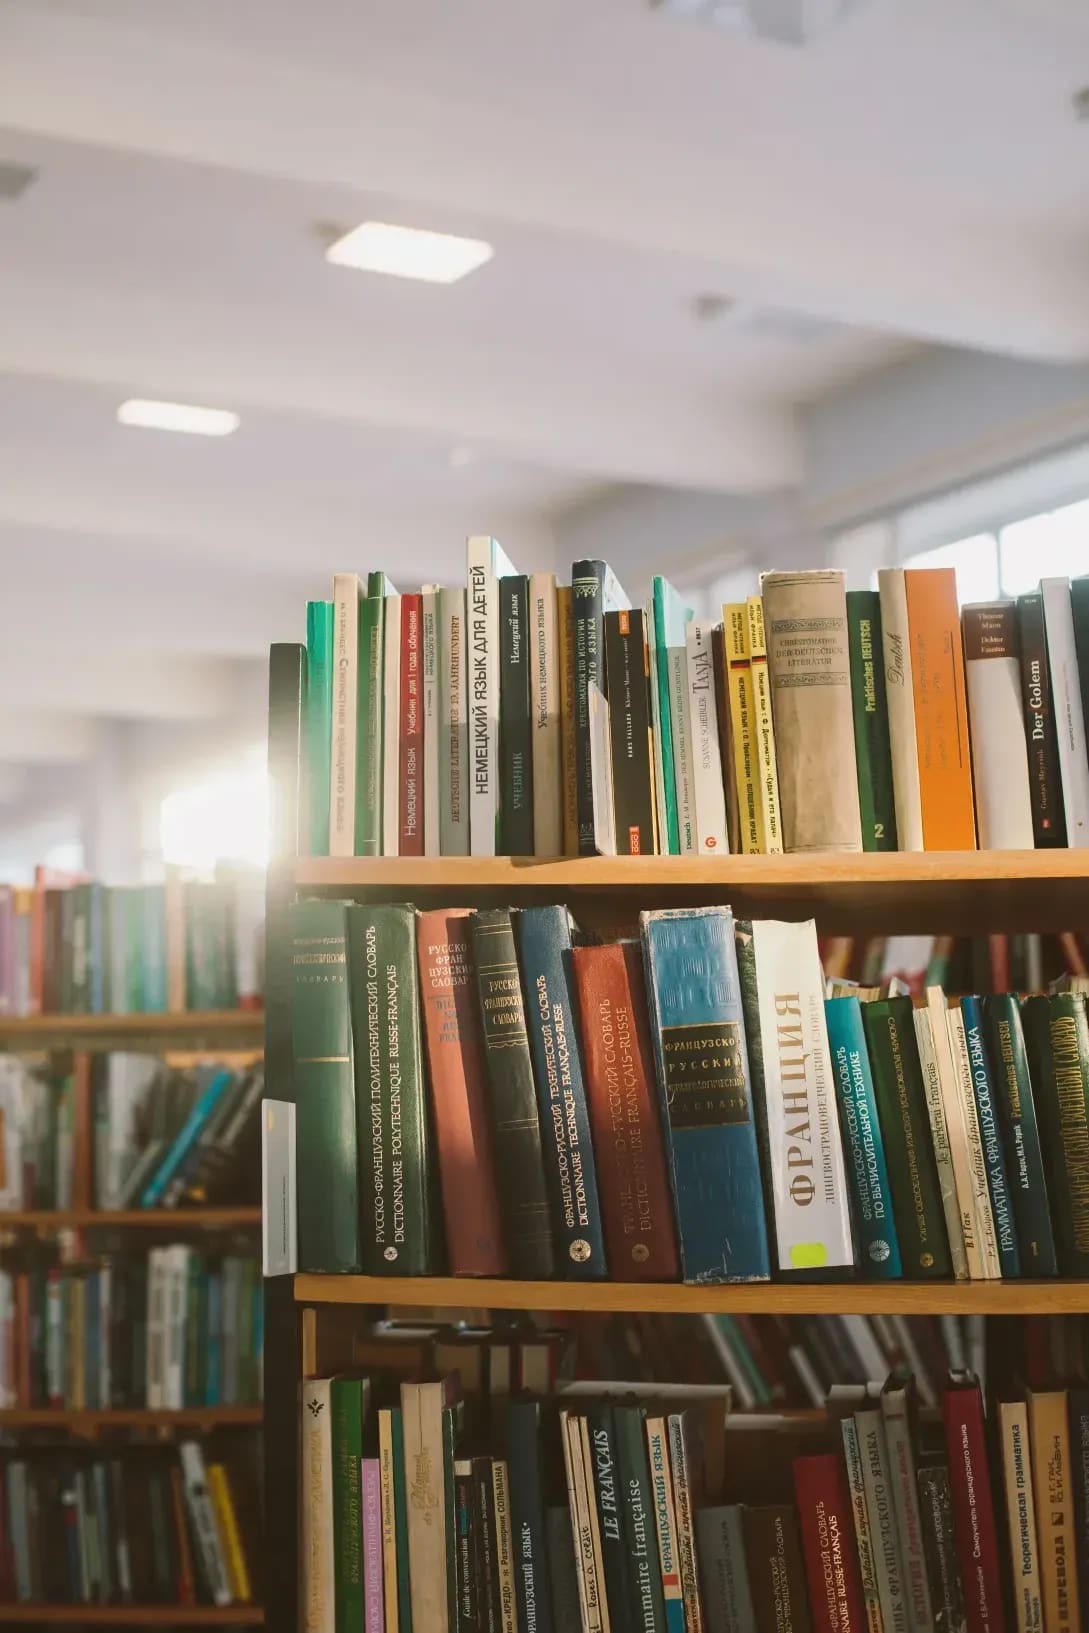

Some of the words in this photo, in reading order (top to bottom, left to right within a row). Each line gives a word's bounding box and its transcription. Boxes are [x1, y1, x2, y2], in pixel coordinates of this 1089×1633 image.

[469, 565, 488, 616] ДЕТЕЙ
[511, 594, 519, 616] язык
[537, 598, 545, 628] языка
[407, 610, 418, 649] обучения
[451, 615, 460, 690] JAHRHUNDERT
[474, 620, 488, 654] ДЛЯ
[508, 618, 520, 664] Немецкий
[576, 618, 586, 657] ИСТОРИИ
[587, 617, 597, 653] ЯЗЫКА
[860, 619, 873, 660] DEUTSCH
[407, 652, 418, 671] года
[474, 656, 488, 700] ЯЗЫК
[538, 630, 549, 684] немецкого
[578, 659, 586, 671] ПО
[691, 650, 712, 694] TANJA
[407, 680, 418, 695] для
[537, 685, 548, 729] Учебник
[578, 673, 588, 729] ХРЕСТОМАТИЯ
[864, 661, 876, 712] Praktisches
[1028, 659, 1042, 708] Golem
[407, 698, 418, 736] Учебник
[450, 708, 460, 767] LITERATUR
[1032, 712, 1044, 741] Der
[407, 747, 417, 775] язык
[472, 705, 489, 795] НЕМЕЦКИЙ
[702, 737, 712, 769] SUSANNE
[451, 769, 460, 823] DEUTSCHE
[512, 751, 523, 809] УЧЕБНИК
[404, 778, 417, 836] Немецкий
[874, 823, 885, 839] 2
[366, 926, 377, 978] СЛОВАРЬ
[387, 965, 399, 1057] RUSSE-FRANÇAIS
[537, 975, 551, 1021] СЛОВАРЬ
[366, 981, 381, 1098] ПОЛИТЕХНИЧЕСКИЙ
[553, 1003, 571, 1086] FRANÇAIS-RUSSE
[600, 998, 616, 1063] СЛОВАРЬ
[887, 1016, 901, 1052] СЛОВАРЬ
[968, 1026, 985, 1067] ЯЗЫКА
[998, 1020, 1014, 1063] DEUTSCH
[1048, 1016, 1081, 1063] СЛОВАРЬ
[542, 1024, 560, 1100] ТЕХНИЧЕСКИЙ
[616, 1007, 640, 1123] FRANÇAIS-RUSSE
[837, 1046, 852, 1093] СЛОВАРЬ
[850, 1051, 866, 1099] ТЕХНИКЕ
[924, 1062, 940, 1106] français
[390, 1062, 403, 1155] POLYTECHNIQUE
[774, 991, 816, 1207] ФРАНЦИЯ
[974, 1070, 998, 1164] ФРАНЦУЗСКОГО
[1006, 1064, 1022, 1119] Praktisches
[1053, 1065, 1087, 1123] ВОЕННЫЙ
[564, 1089, 580, 1148] TECHNIQUE
[813, 1048, 835, 1205] ЛИНГВОСТРАНОВЕДЧЕСКИЙ
[930, 1109, 948, 1150] parlerai
[370, 1103, 385, 1243] РУССКО-ФРАНЦУЗСКИЙ
[551, 1103, 575, 1228] ФРАНЦУЗСКО-РУССКИЙ
[843, 1095, 872, 1221] ФРАНЦУЗСКО-РУССКИЙ
[857, 1099, 883, 1199] ВЫЧИСЛИТЕЛЬНОЙ
[937, 1152, 949, 1165] Je
[972, 1148, 987, 1199] Учебник
[392, 1160, 405, 1242] DICTIONNAIRE
[572, 1151, 589, 1226] DICTIONNAIRE
[874, 1201, 885, 1218] ПО
[991, 1166, 1014, 1252] ГРАММАТИКА
[651, 1435, 664, 1472] ЯЗЫК
[866, 1430, 882, 1477] ЯЗЫКА
[960, 1423, 969, 1449] языка
[1011, 1424, 1026, 1489] грамматика
[593, 1429, 617, 1512] FRANÇAIS
[963, 1450, 976, 1506] французского
[521, 1527, 533, 1558] ЯЗЫК
[603, 1516, 620, 1540] LE
[628, 1479, 648, 1556] française
[654, 1476, 672, 1573] ФРАНЦУЗСКИЙ
[816, 1501, 829, 1548] СЛОВАРЬ
[875, 1484, 900, 1596] ФРАНЦУЗСКОГО
[970, 1507, 981, 1558] Самоучитель
[1017, 1493, 1033, 1577] Теоретическая
[460, 1538, 470, 1583] conversation
[828, 1515, 847, 1597] RUSSE-FRANÇAIS
[1054, 1535, 1069, 1620] ПЕРЕВОДА
[462, 1584, 470, 1593] de
[462, 1594, 471, 1617] Guide
[588, 1578, 598, 1608] Roses
